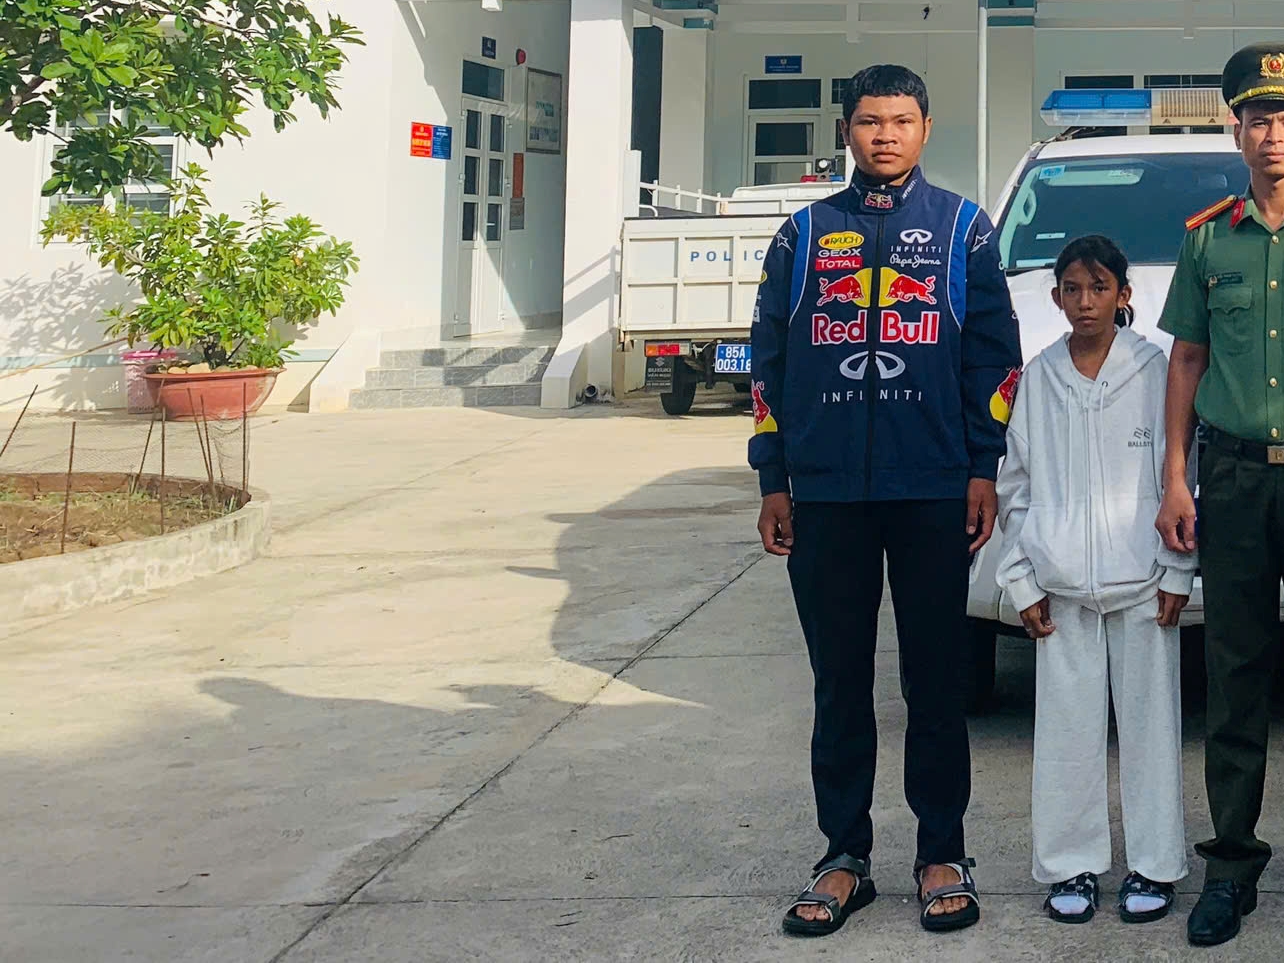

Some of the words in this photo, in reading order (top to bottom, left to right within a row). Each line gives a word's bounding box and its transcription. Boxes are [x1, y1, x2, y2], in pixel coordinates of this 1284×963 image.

[830, 236, 859, 246] RAUCH
[818, 247, 863, 258] GEOX
[890, 245, 943, 253] INFINITI
[690, 250, 764, 262] POLIC
[811, 309, 868, 346] Red
[880, 309, 940, 345] Bull
[725, 346, 746, 359] 85A
[822, 389, 922, 404] INFINITI
